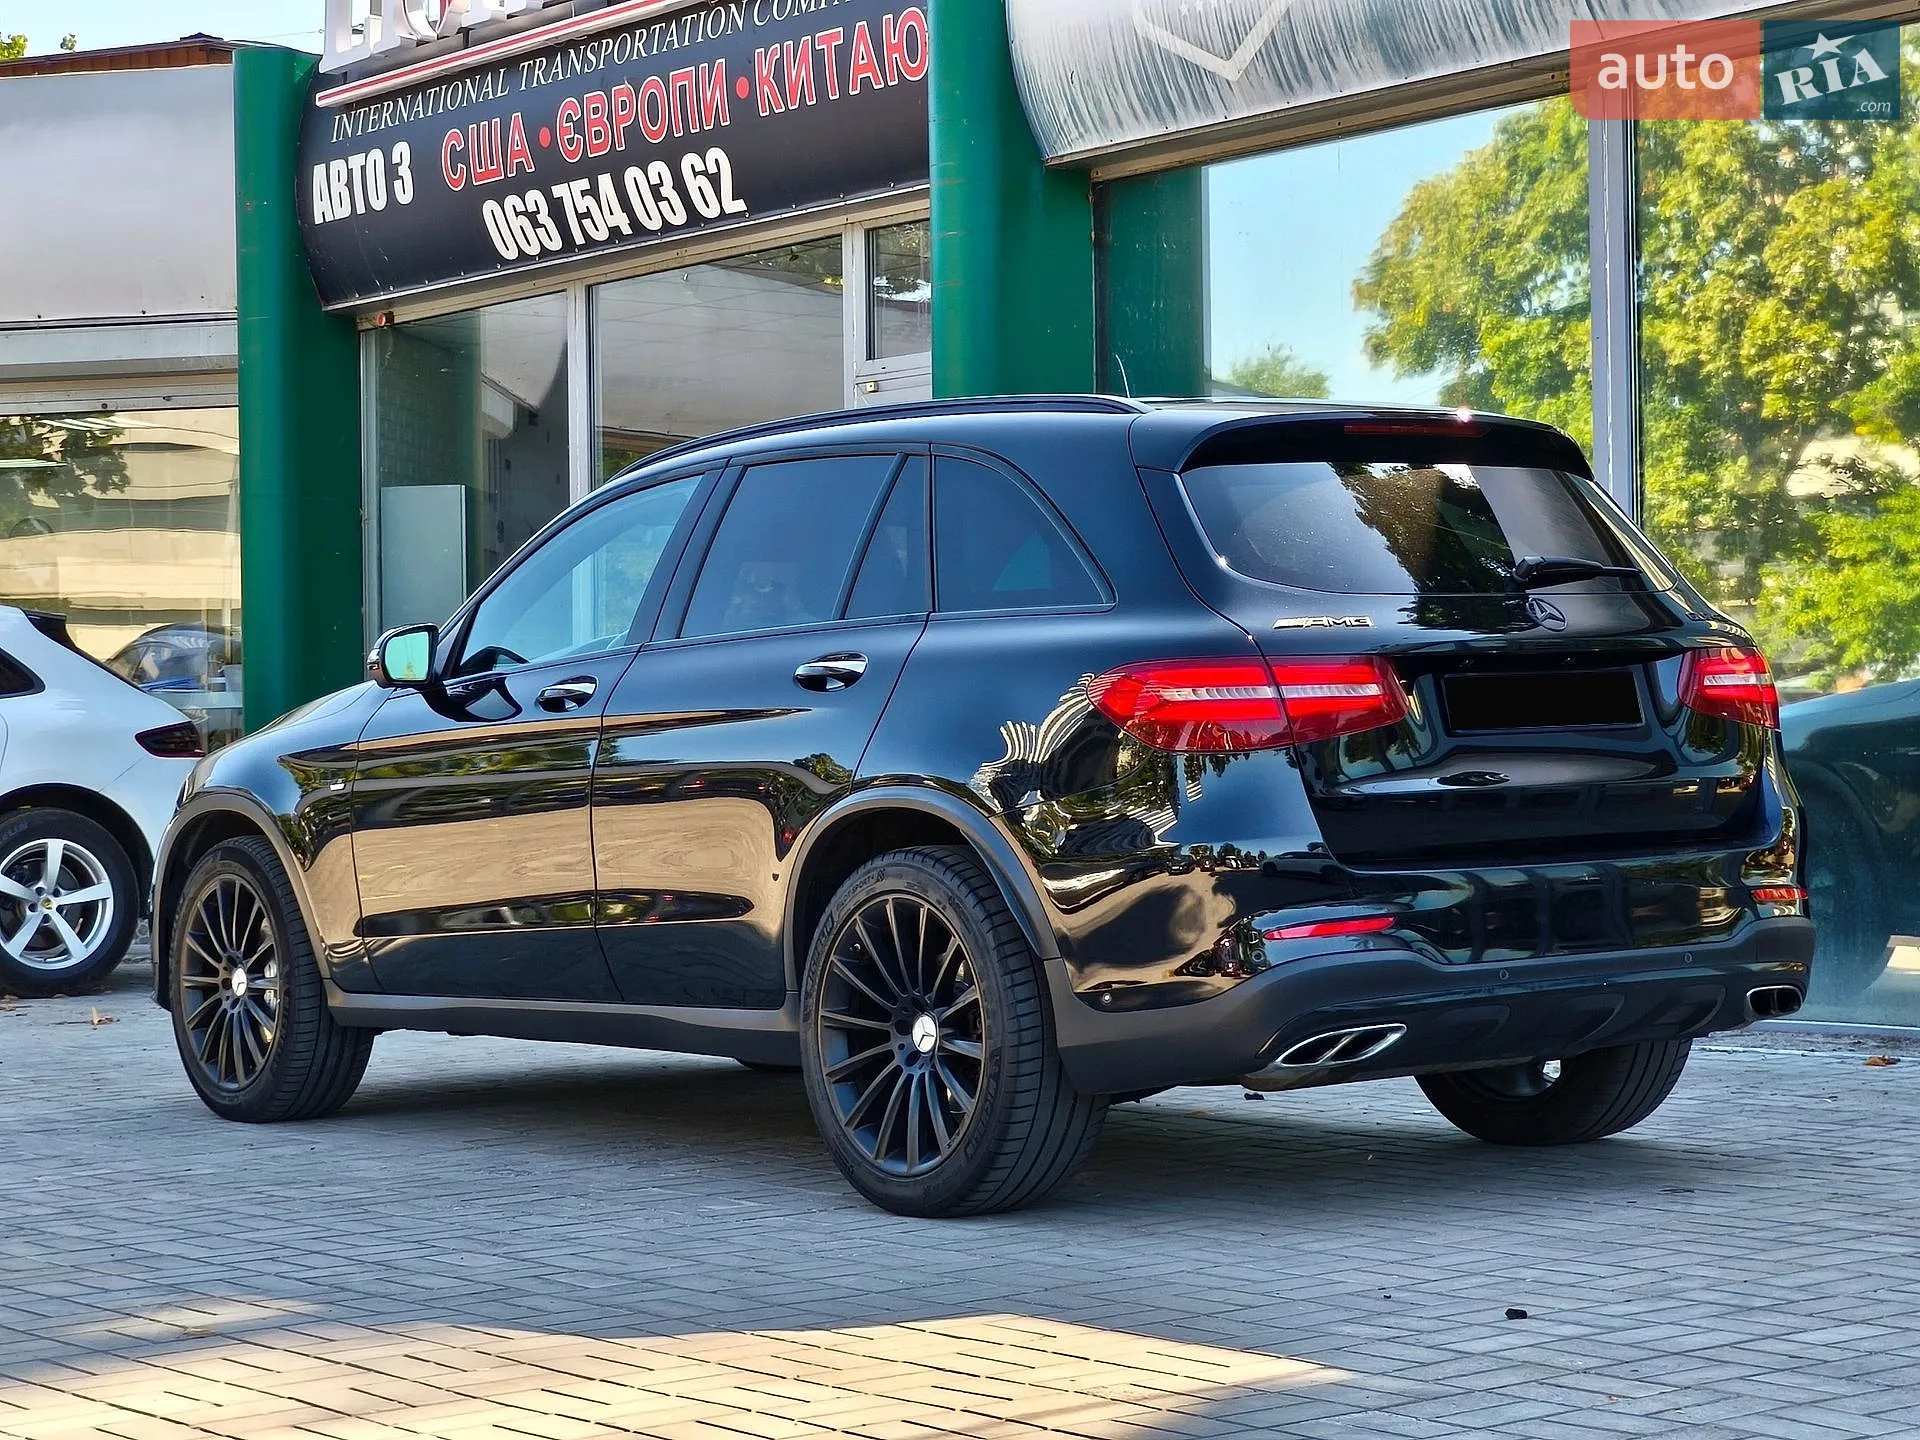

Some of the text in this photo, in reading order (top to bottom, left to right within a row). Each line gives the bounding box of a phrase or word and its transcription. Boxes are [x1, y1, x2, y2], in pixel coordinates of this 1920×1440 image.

[312, 148, 388, 225] АВТО
[441, 112, 535, 192] США
[556, 58, 731, 163] ЄВРОПИ
[754, 6, 929, 117] КИТАЮ
[331, 67, 510, 143] INTERNATIONAL
[519, 0, 746, 92] TRANSPORTATION
[482, 146, 748, 261] 063 754 03 62
[1302, 615, 1374, 628] AMG
